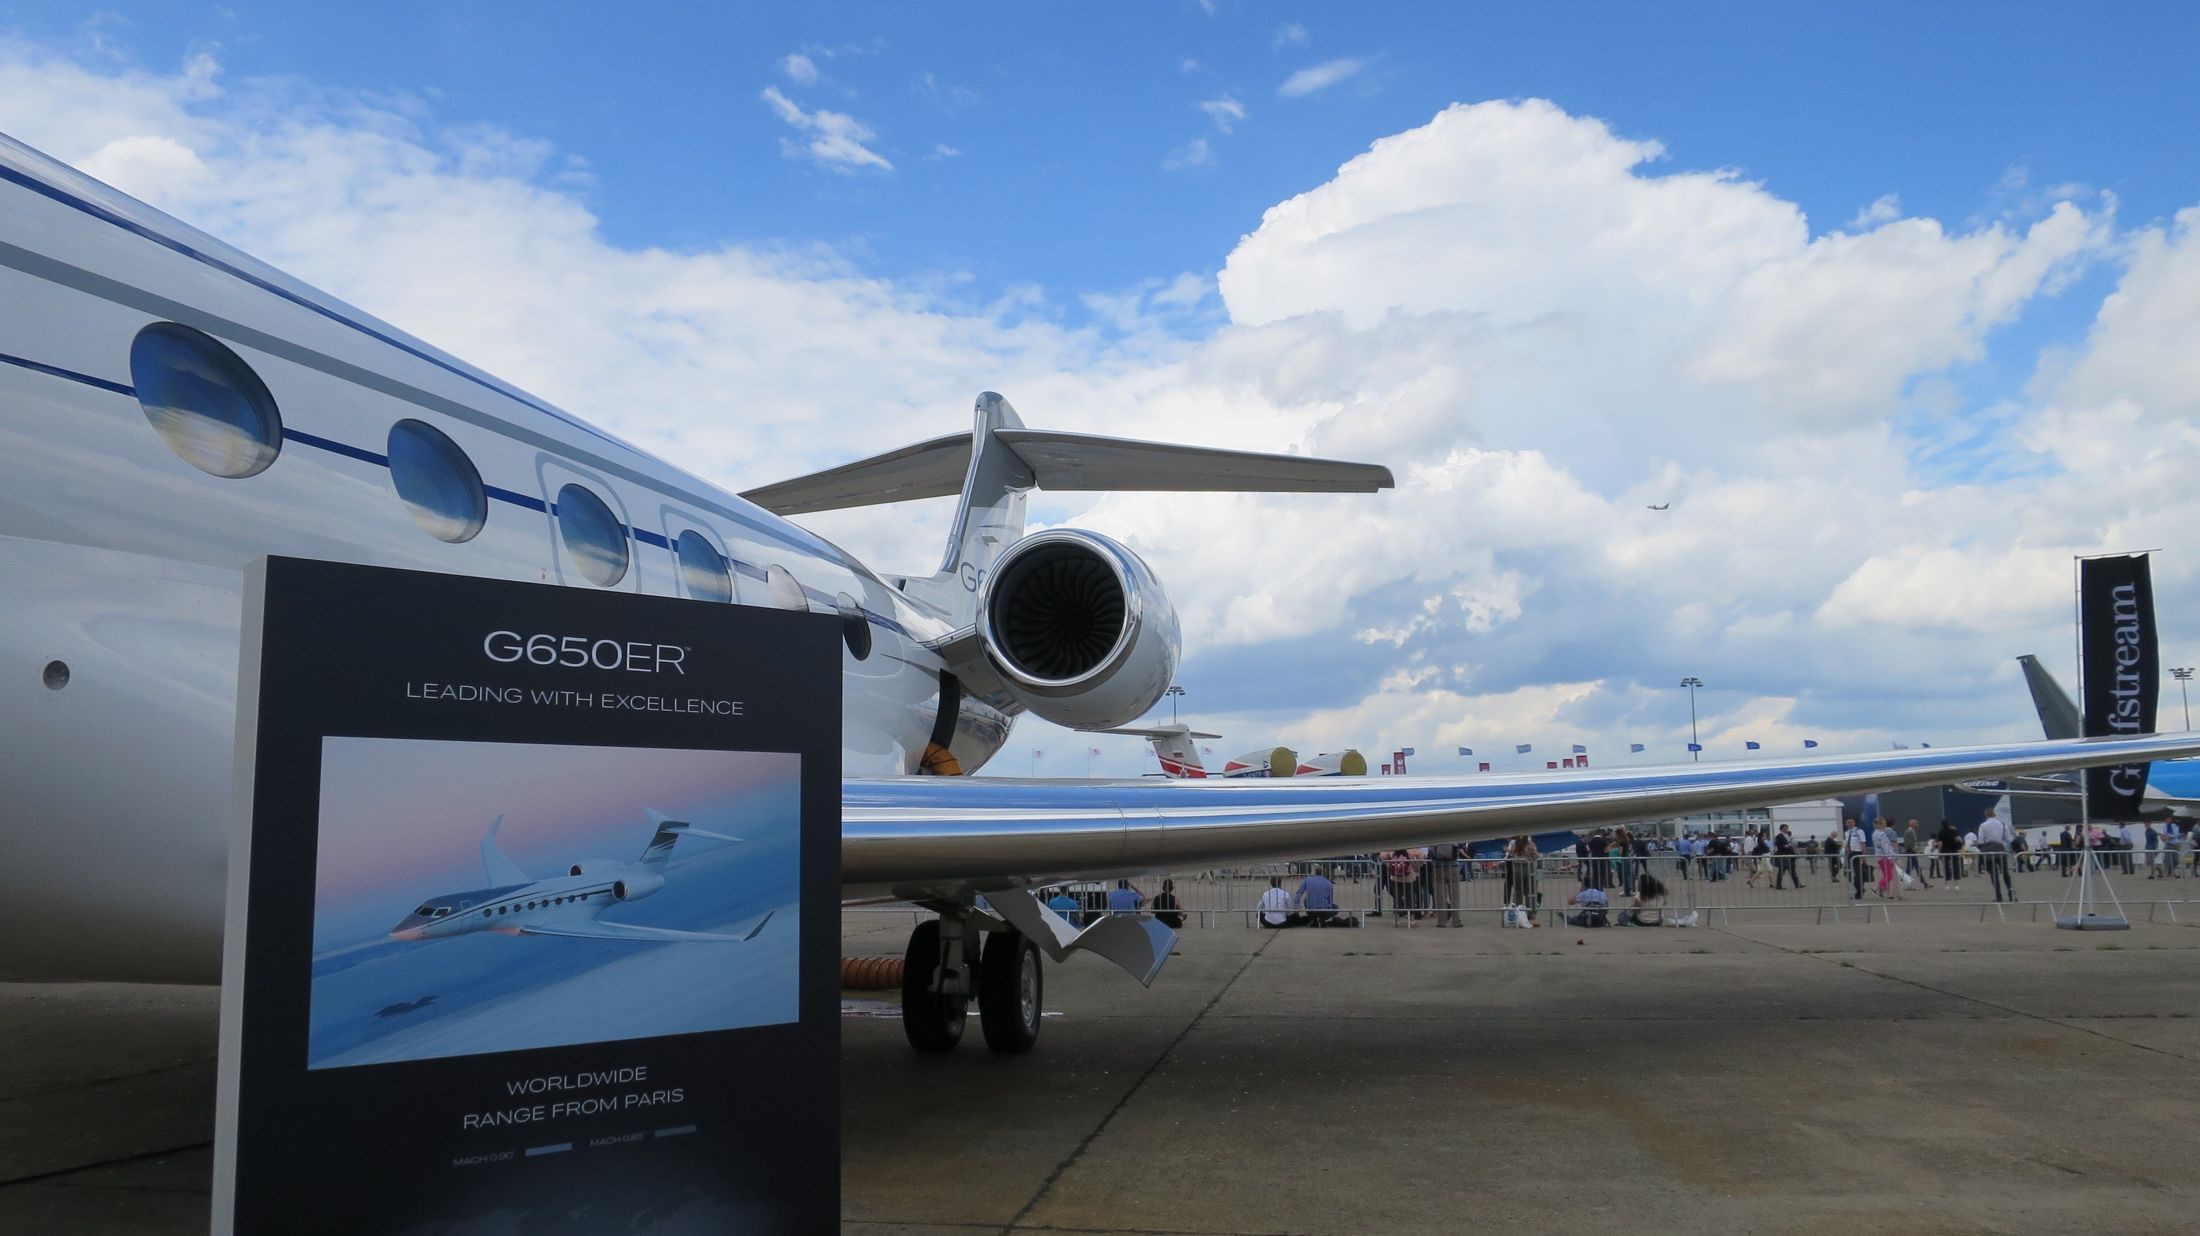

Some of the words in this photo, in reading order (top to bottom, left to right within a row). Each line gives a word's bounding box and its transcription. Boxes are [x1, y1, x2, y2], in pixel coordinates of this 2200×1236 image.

[406, 681, 523, 704] LEADING
[530, 689, 593, 707] WITH
[601, 693, 744, 715] EXCELLENCE
[2108, 581, 2141, 796] Gfstream
[506, 1066, 648, 1096] WORLDWIDE
[463, 1105, 546, 1130] RANGE
[551, 1096, 618, 1119] FROM
[624, 1088, 685, 1110] PARIS
[590, 1136, 622, 1147] MACH
[453, 1156, 488, 1168] MACH
